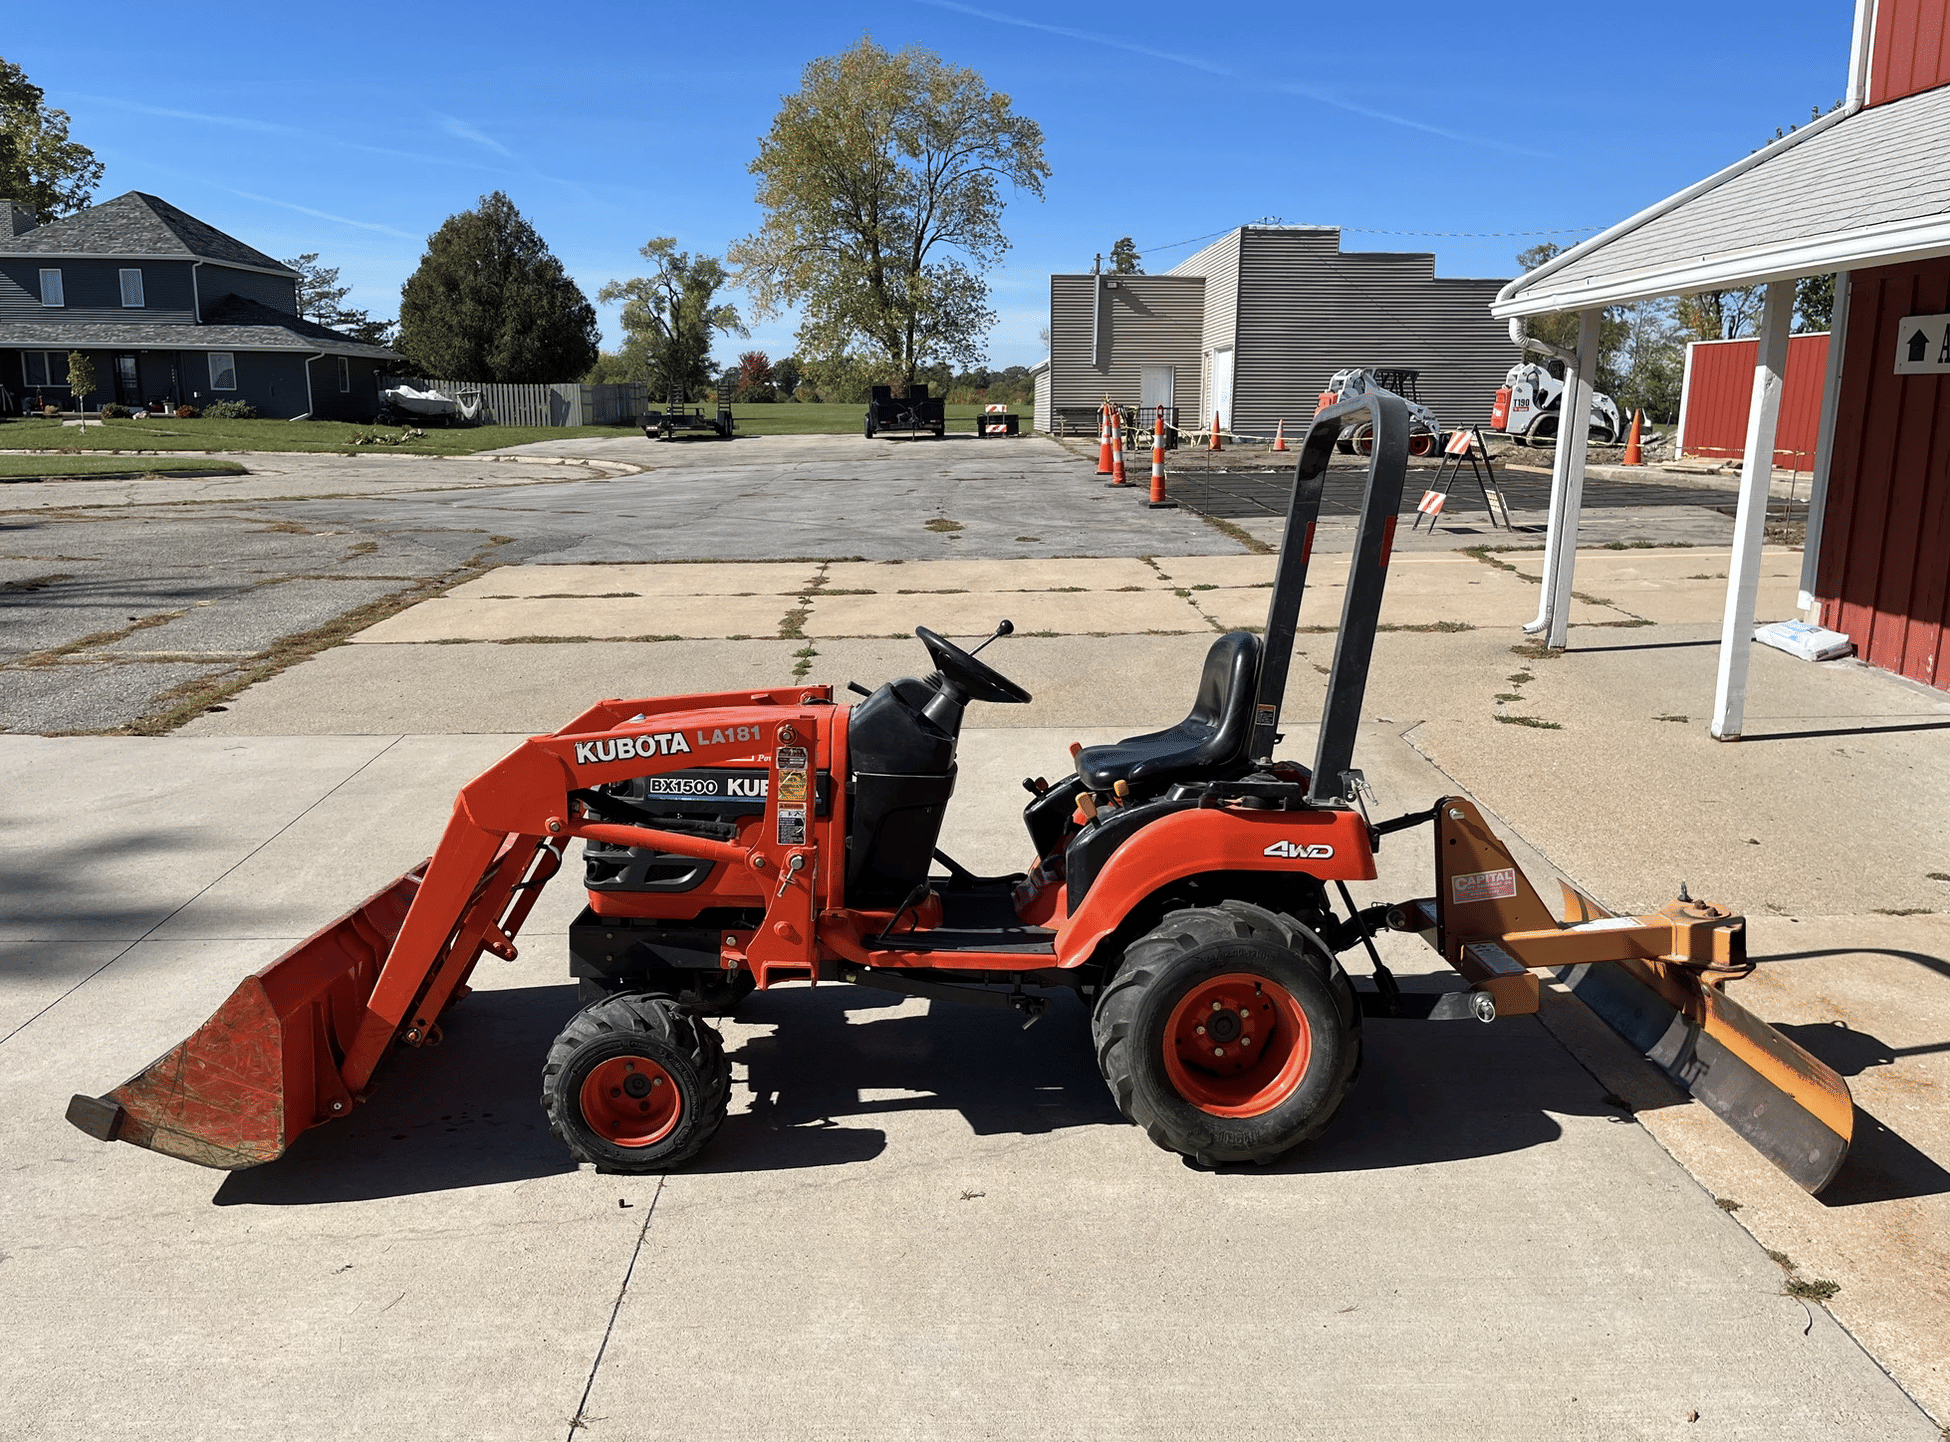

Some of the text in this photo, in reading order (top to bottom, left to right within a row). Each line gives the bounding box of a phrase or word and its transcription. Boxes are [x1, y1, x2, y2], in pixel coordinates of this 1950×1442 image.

[1513, 398, 1530, 407] T190
[575, 725, 761, 764] KUBOTA LA181
[650, 777, 718, 795] BX1500
[1263, 840, 1334, 859] 4WD
[1455, 871, 1513, 890] CAPITAL
